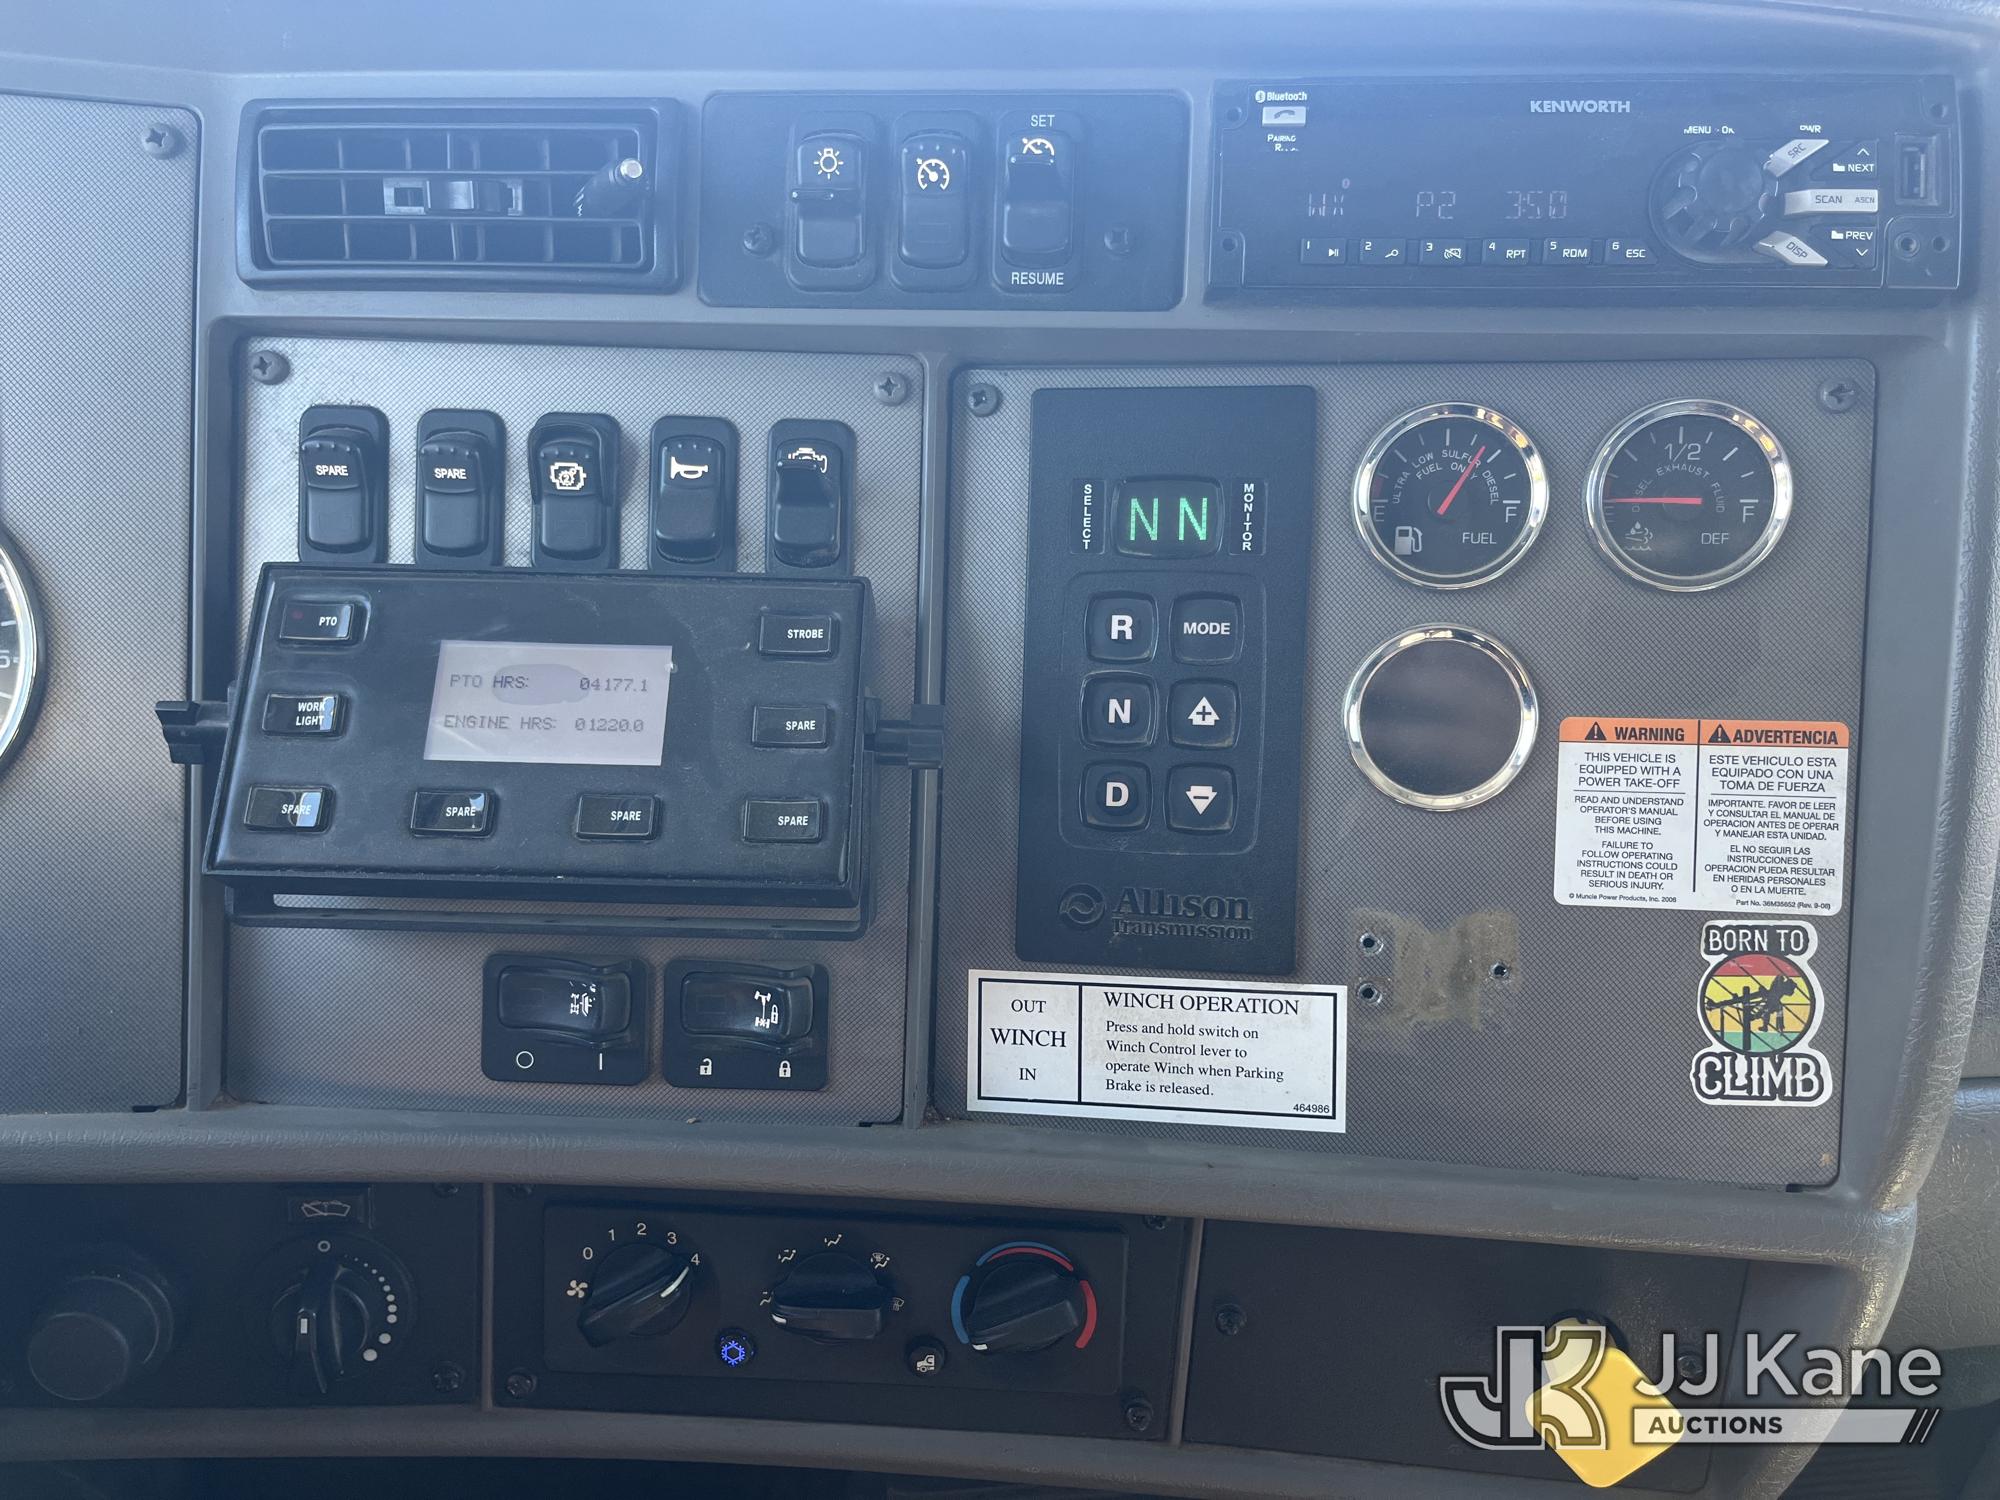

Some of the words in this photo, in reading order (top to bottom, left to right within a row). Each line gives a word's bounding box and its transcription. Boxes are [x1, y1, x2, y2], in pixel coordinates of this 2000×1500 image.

[1267, 91, 1307, 101] Bluetooth
[1530, 100, 1631, 113] KENWORTH
[1031, 115, 1055, 128] SET
[1684, 126, 1711, 134] MENU
[1788, 143, 1807, 158] SRC
[1848, 164, 1874, 172] NEXT
[1815, 195, 1842, 204] SCAN
[1846, 232, 1873, 240] PREV
[1506, 249, 1525, 258] RPT
[1563, 248, 1587, 258] RDM
[1626, 249, 1646, 258] ESC
[1786, 241, 1807, 259] DISP
[1011, 272, 1064, 285] RESUME
[1664, 443, 1701, 462] 1/2
[1412, 452, 1434, 468] LOW
[1441, 450, 1481, 468] SULFUR
[316, 465, 349, 476] SPARE
[434, 468, 467, 479] SPARE
[1416, 463, 1442, 480] FUEL
[1393, 471, 1410, 504] ULTRA
[1482, 471, 1499, 504] DIESEL
[1656, 464, 1710, 479] EXHAUST
[1712, 482, 1725, 513] FLUID
[1082, 484, 1092, 550] SELECT
[1243, 484, 1254, 551] MONITOR
[1506, 507, 1517, 523] F
[1743, 506, 1755, 523] F
[1462, 532, 1496, 544] FUEL
[1702, 533, 1730, 544] DEF
[319, 617, 337, 626] PTO
[1110, 615, 1133, 640] R
[1183, 623, 1230, 635] MODE
[787, 629, 824, 639] STROBE
[450, 674, 482, 687] PTO
[493, 675, 529, 689] HRS:
[579, 678, 647, 691] 04177.1
[298, 703, 325, 711] WORK
[1108, 699, 1131, 723] N
[296, 716, 324, 725] LIGHT
[444, 715, 509, 729] ENGINE
[520, 717, 557, 730] HRS:
[575, 718, 644, 732] 01220.0
[786, 721, 816, 730] SPARE
[1614, 727, 1684, 741] WARNING
[1733, 729, 1838, 744] ADVERTENCIA
[1585, 752, 1610, 761] THIS
[1613, 753, 1661, 763] VEHICLE
[1666, 755, 1676, 763] IS
[1709, 755, 1740, 764] ESTE
[1742, 756, 1803, 766] VEHICULO
[1807, 758, 1836, 767] ESTA
[1579, 765, 1637, 775] EQUIPPED
[1641, 766, 1669, 775] WITH
[1673, 767, 1681, 776] A
[1712, 768, 1773, 779] EQUIPADO
[1776, 769, 1803, 778] CON
[1808, 770, 1833, 780] UNA
[1579, 777, 1621, 786] POWER
[1624, 778, 1680, 788] TAKE-OFF
[1720, 781, 1754, 790] TOMA
[1758, 782, 1774, 791] DE
[1777, 783, 1825, 792] FUERZA
[1106, 782, 1129, 806] D
[1575, 796, 1598, 804] READ
[1623, 797, 1684, 806] UNDERSTAND
[1768, 801, 1797, 809] FAVOR
[281, 804, 312, 815] SPARE
[446, 807, 476, 817] SPARE
[1580, 806, 1636, 814] OPERATOR'S
[1716, 810, 1768, 818] CONSULTAR
[1783, 812, 1820, 820] MANUAL
[611, 811, 641, 820] SPARE
[778, 816, 808, 826] SPARE
[1595, 816, 1630, 824] BEFORE
[1595, 826, 1614, 834] THIS
[1617, 827, 1661, 835] MACHINE.
[1704, 820, 1756, 828] OPERACION
[1758, 821, 1786, 829] ANTES
[1802, 823, 1839, 831] OPERAR
[1723, 830, 1764, 838] MANEJAR
[1767, 831, 1788, 839] ESTA
[1791, 832, 1827, 840] UNIDAD.
[1602, 841, 1638, 849] FAILURE
[1758, 846, 1791, 854] SEGUIR
[1793, 847, 1810, 855] LAS
[1582, 850, 1620, 858] FOLLOW
[1622, 852, 1673, 860] OPERATING
[1727, 856, 1798, 865] INSTRUCCIONES
[1577, 860, 1643, 869] INSTRUCTIONS
[1581, 870, 1614, 878] RESULT
[1628, 872, 1658, 880] DEATH
[1704, 865, 1756, 873] OPERACION
[1758, 866, 1788, 874] PUEDA
[1790, 868, 1835, 876] RESULTAR
[1589, 880, 1628, 888] SERIOUS
[1631, 881, 1664, 890] INJURY.
[1727, 875, 1765, 883] HERIDAS
[1767, 876, 1826, 886] PERSONALES
[1767, 887, 1806, 895] MUERTE.
[1114, 886, 1252, 920] Allison
[1112, 918, 1252, 940] Transmission
[1709, 930, 1767, 951] BORN
[1776, 930, 1803, 951] TO
[1011, 999, 1046, 1013] OUT
[1104, 992, 1174, 1009] WINCH
[1180, 995, 1299, 1015] OPERATION
[1106, 1021, 1138, 1034] Press
[1142, 1022, 1163, 1034] and
[1167, 1023, 1195, 1036] hold
[1198, 1024, 1239, 1038] switch
[1243, 1029, 1259, 1039] on
[990, 1028, 1067, 1047] WINCH
[1106, 1040, 1146, 1053] Winch
[1149, 1042, 1196, 1055] Control
[1200, 1045, 1231, 1057] lever
[1235, 1048, 1247, 1058] to
[1019, 1068, 1036, 1080] IN
[1106, 1062, 1150, 1075] operate
[1154, 1062, 1194, 1075] Winch
[1198, 1065, 1232, 1077] when
[1236, 1067, 1284, 1082] Parking
[1700, 1056, 1819, 1097] CLIMB
[1106, 1079, 1142, 1092] Brake
[1146, 1081, 1155, 1093] is
[1159, 1081, 1214, 1096] released.
[1293, 1103, 1330, 1114] 464986
